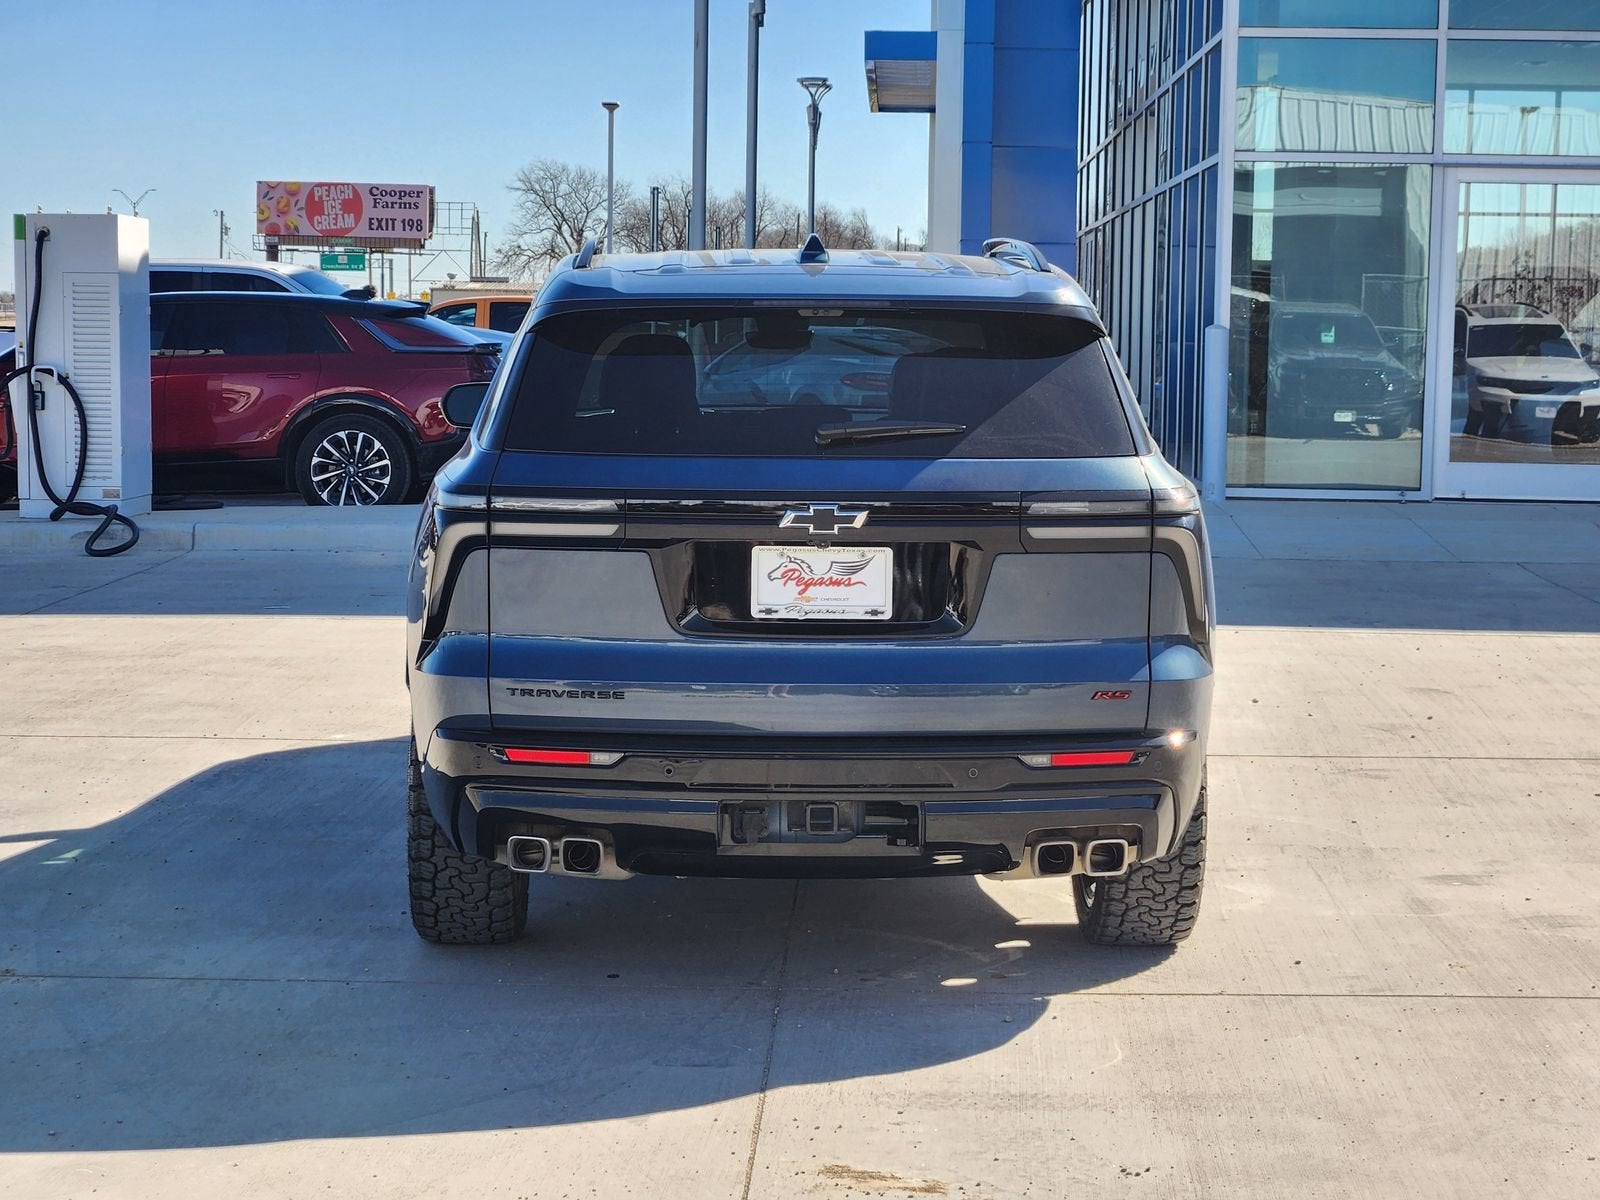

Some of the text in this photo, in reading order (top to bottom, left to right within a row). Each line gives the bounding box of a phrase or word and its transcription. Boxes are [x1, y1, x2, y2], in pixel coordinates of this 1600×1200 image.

[313, 184, 353, 201] PEACH
[369, 186, 424, 200] Cooper
[323, 200, 343, 215] ICE
[372, 198, 420, 210] Farms
[313, 213, 355, 230] CREAM
[368, 217, 423, 232] EXIT 198
[780, 567, 867, 596] Pegasus
[506, 687, 625, 700] TRAVERSE
[1090, 690, 1132, 701] RS
